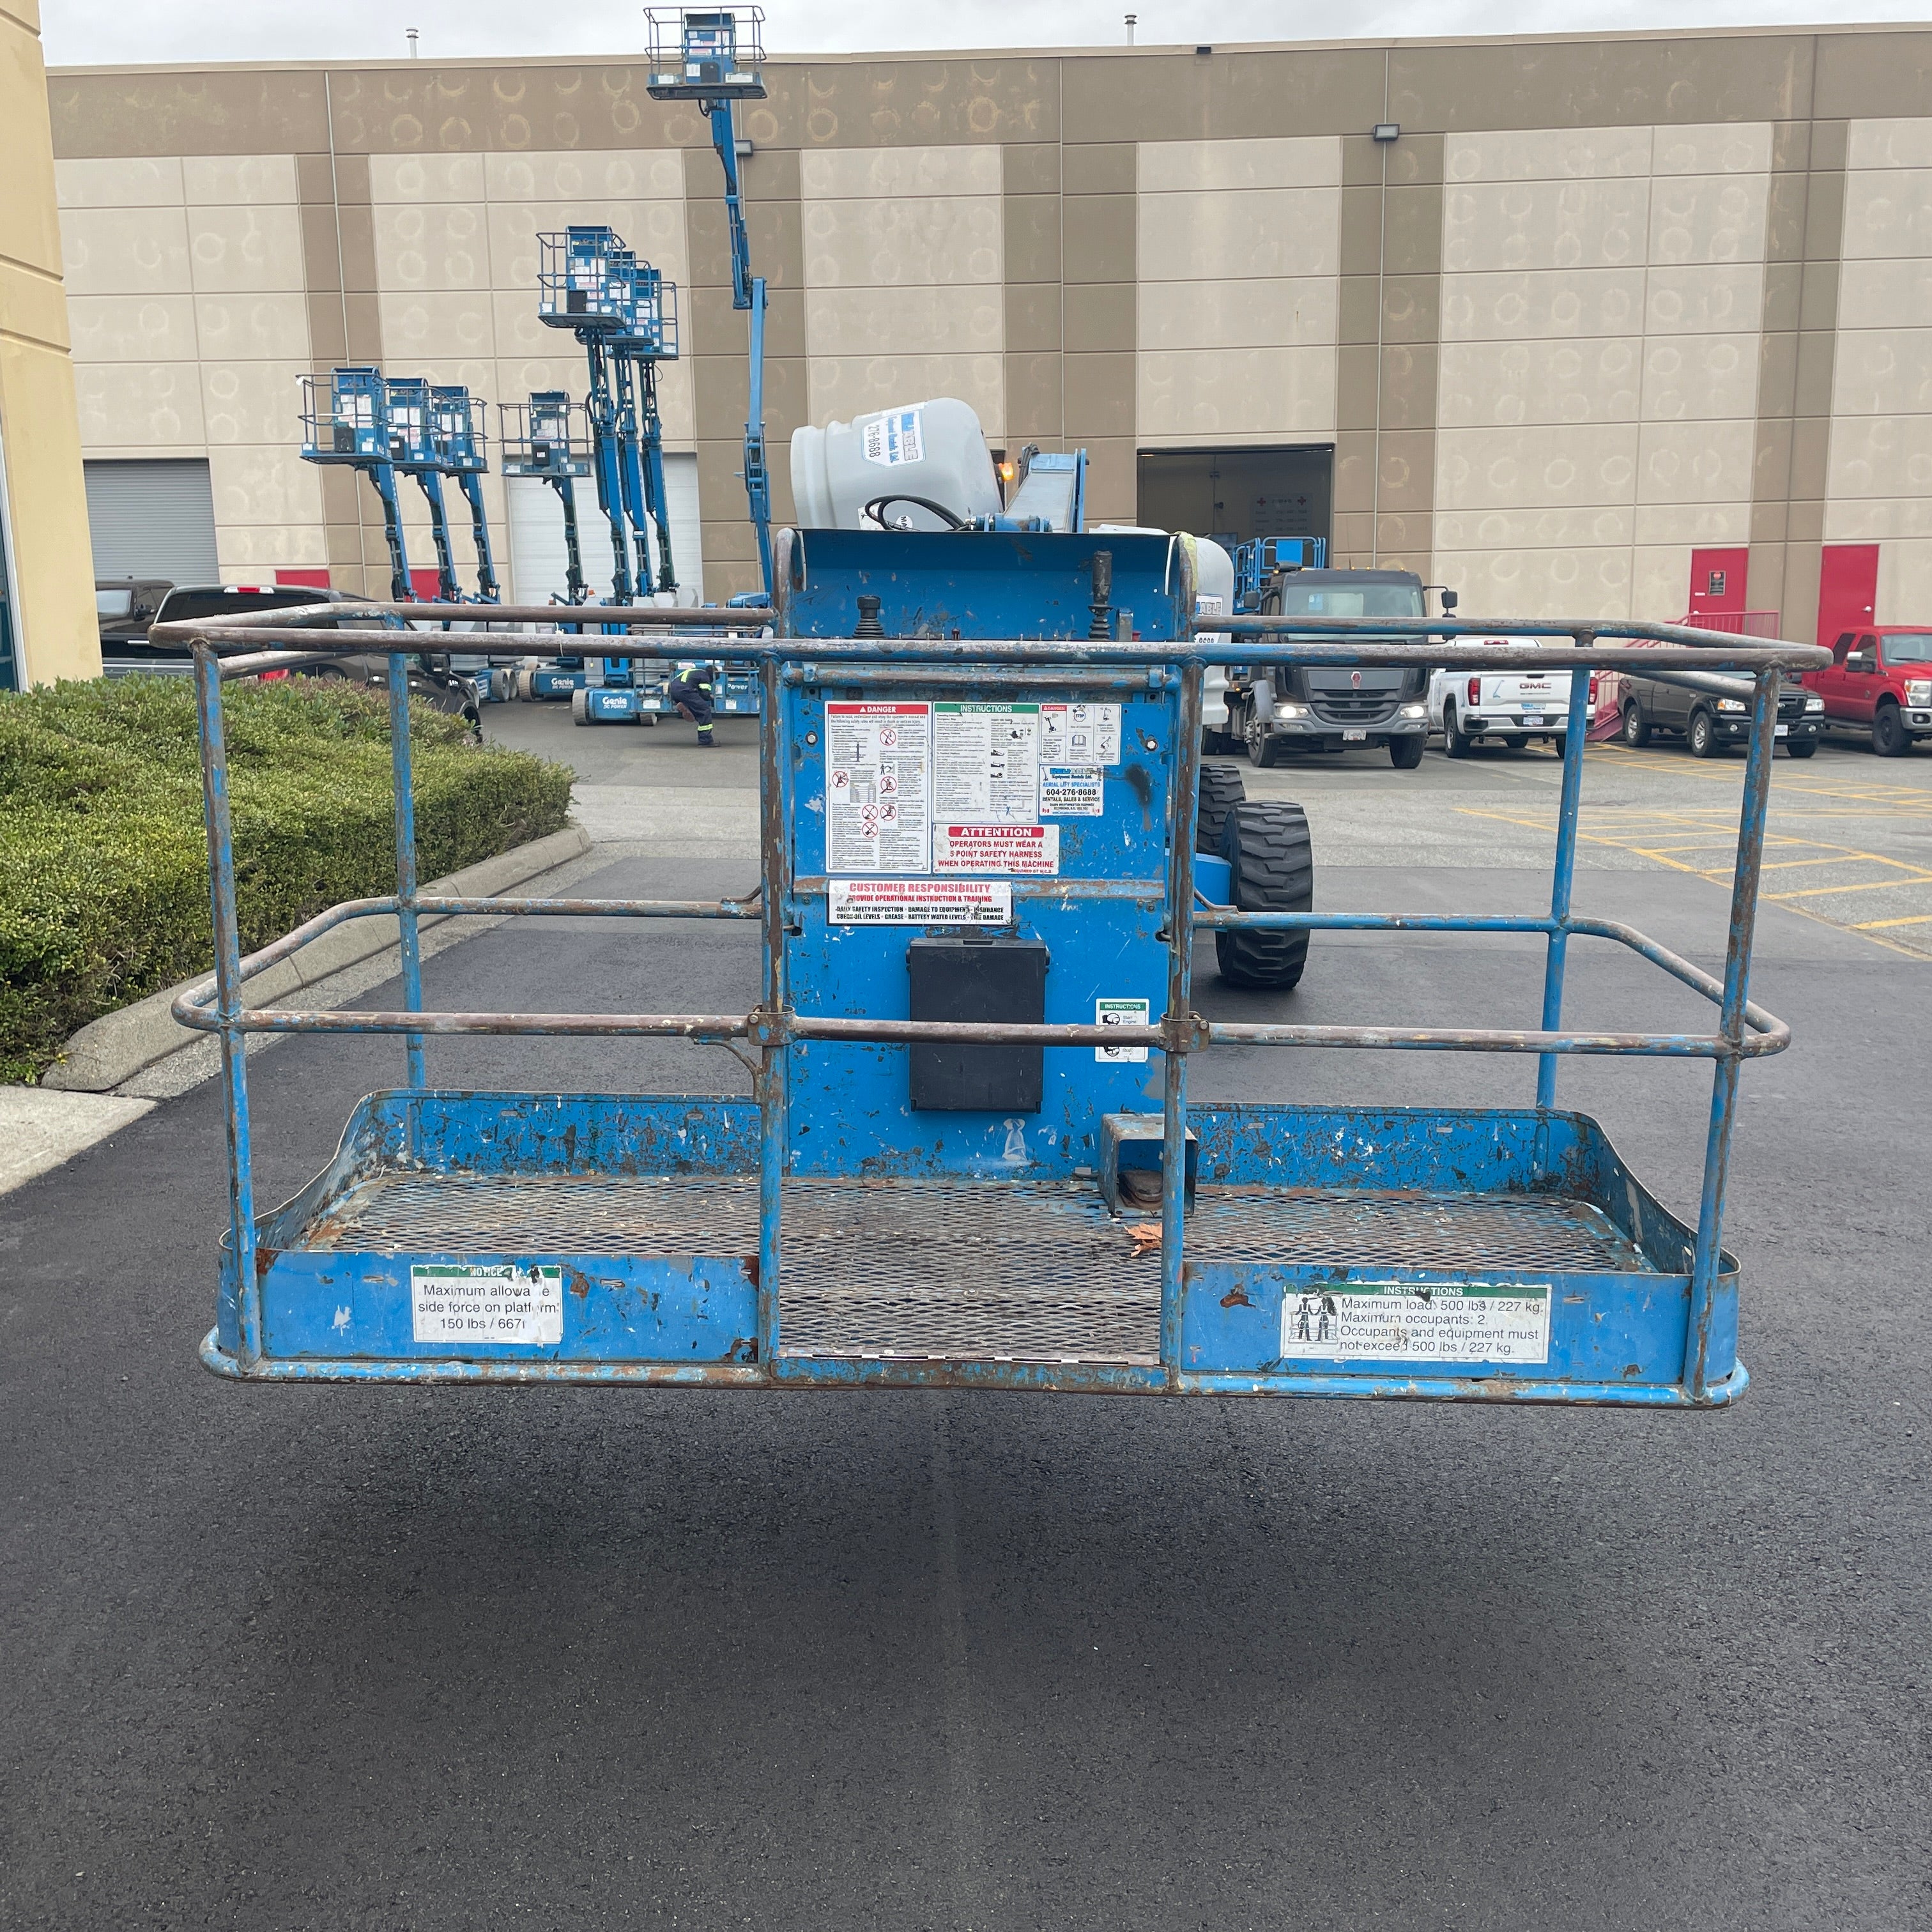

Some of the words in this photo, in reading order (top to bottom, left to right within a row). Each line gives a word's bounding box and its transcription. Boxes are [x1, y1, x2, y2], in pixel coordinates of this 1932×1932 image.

[868, 424, 881, 457] 276-8688
[551, 677, 574, 686] Genie
[602, 696, 627, 705] Genie
[960, 827, 1032, 837] ATTENTION
[850, 883, 905, 893] CUSTOMER
[908, 884, 991, 893] RESPONSIBILITY
[470, 1267, 503, 1276] NOTICE
[424, 1285, 486, 1296] Maximum
[490, 1285, 549, 1296] allowae
[418, 1301, 444, 1312] side
[449, 1301, 480, 1312] force
[1342, 1299, 1402, 1310] Maximum
[1406, 1300, 1436, 1310] load:
[1440, 1300, 1464, 1310] 500
[1468, 1300, 1486, 1311] lbs
[1489, 1301, 1494, 1311] /
[1498, 1301, 1521, 1312] 227
[1525, 1301, 1544, 1314] kg.
[441, 1318, 463, 1329] 150
[468, 1318, 486, 1329] lbs
[489, 1318, 494, 1329] /
[1341, 1312, 1401, 1323] Maximum
[1406, 1314, 1474, 1327] occupants:
[1477, 1315, 1488, 1324] 2.
[1340, 1326, 1407, 1340] Occupants
[1411, 1327, 1434, 1337] and
[1439, 1328, 1505, 1342] equipment
[1508, 1330, 1538, 1340] must
[1340, 1340, 1359, 1350] not
[1363, 1340, 1407, 1351] exceed
[1412, 1342, 1436, 1351] 500
[1439, 1342, 1457, 1352] lbs
[1460, 1342, 1466, 1352] /
[1469, 1343, 1492, 1353] 227
[1496, 1342, 1515, 1355] kg.
